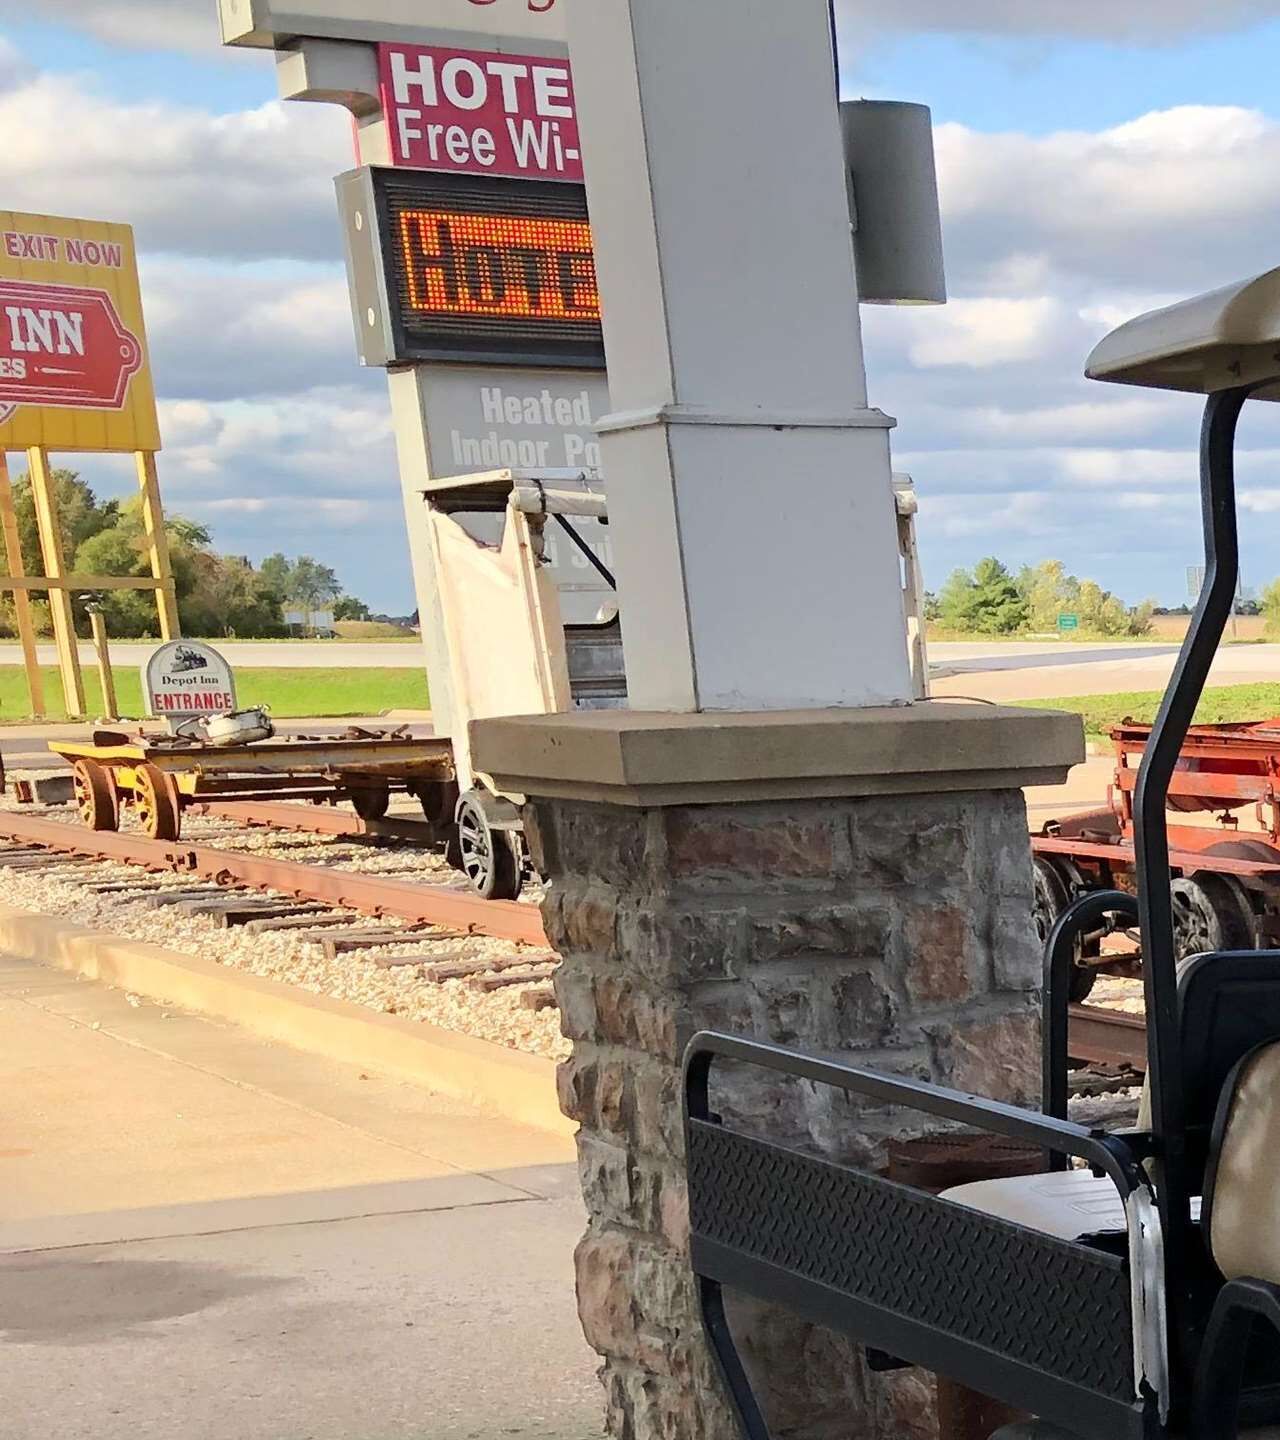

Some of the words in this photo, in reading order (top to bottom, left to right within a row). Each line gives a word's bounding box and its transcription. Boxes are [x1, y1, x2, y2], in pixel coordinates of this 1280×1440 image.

[397, 108, 496, 166] Free
[4, 232, 57, 260] EXIT
[65, 239, 121, 267] NOW
[6, 306, 84, 356] INN
[480, 387, 591, 426] Heated
[451, 430, 548, 466] Indoor
[162, 675, 197, 686] Depot
[200, 675, 219, 685] Inn
[154, 692, 233, 711] ENTRANCE
